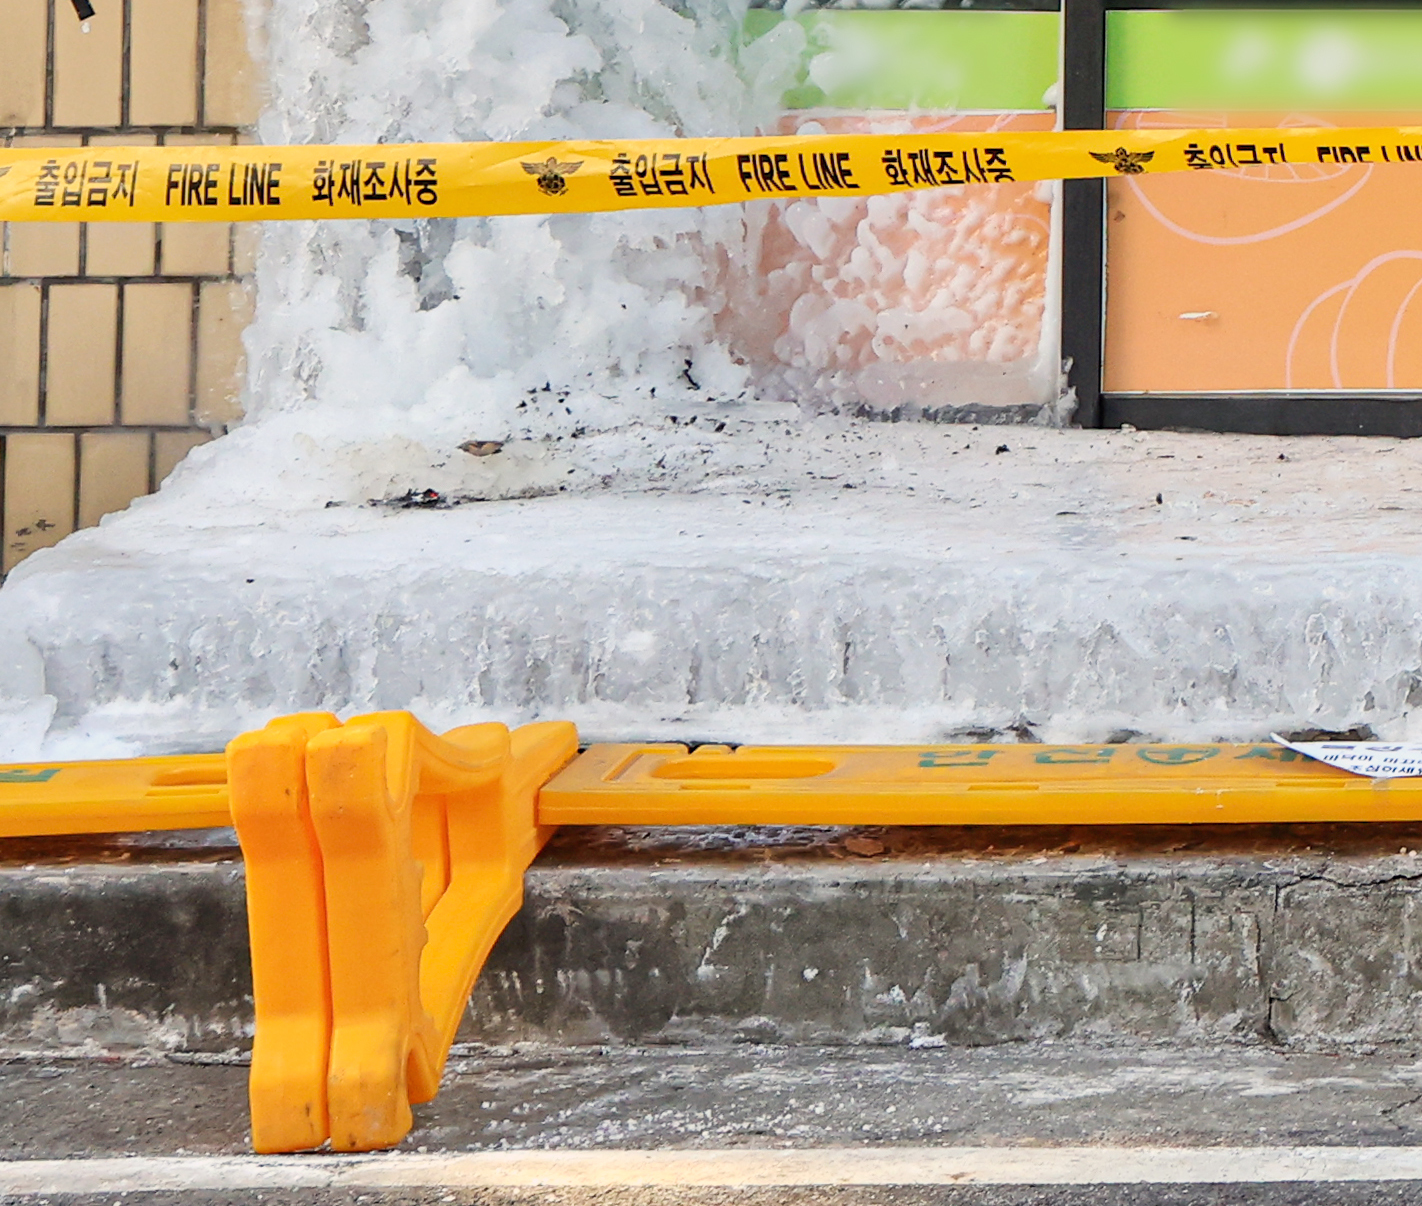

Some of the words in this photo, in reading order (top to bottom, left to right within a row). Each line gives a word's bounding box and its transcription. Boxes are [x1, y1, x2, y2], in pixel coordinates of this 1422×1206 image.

[34, 159, 140, 207] 출입금지
[164, 163, 221, 207] FIRE
[228, 162, 283, 206] LINE
[312, 158, 438, 206] 화재조사중
[608, 152, 716, 196] 출입금지
[736, 153, 799, 193] FIRE
[798, 152, 860, 190] LINE
[881, 147, 1016, 188] 화재조사중
